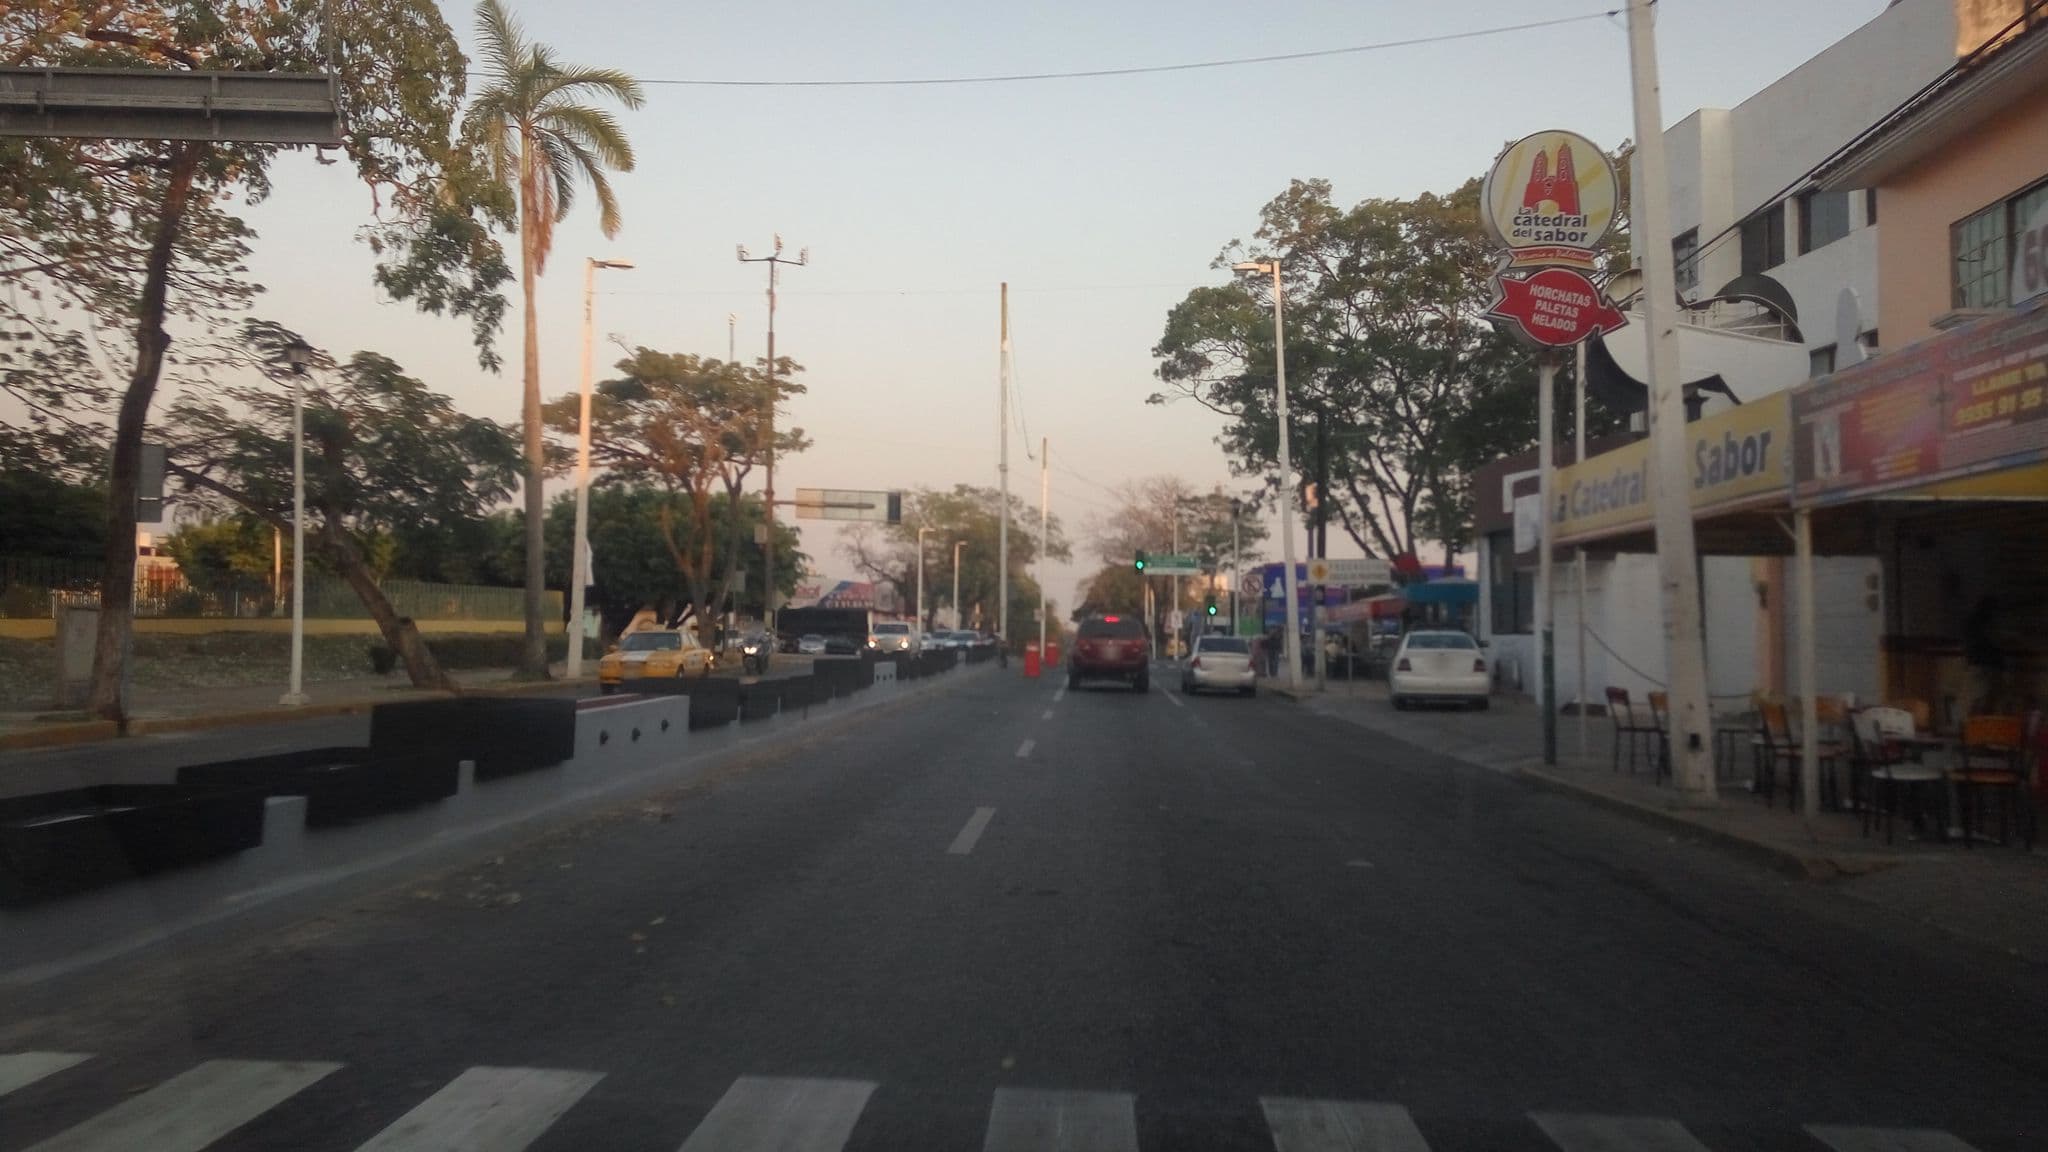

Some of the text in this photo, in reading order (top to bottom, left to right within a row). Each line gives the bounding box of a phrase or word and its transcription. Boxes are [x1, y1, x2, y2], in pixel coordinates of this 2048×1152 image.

[1513, 213, 1588, 228] catedral
[1512, 228, 1588, 242] del sabor
[1529, 284, 1592, 308] HORCHATAS
[1535, 299, 1580, 318] PALETAS
[1531, 312, 1578, 332] HELADOS
[1570, 459, 1648, 517] Catedral
[1694, 430, 1772, 489] Sabor
